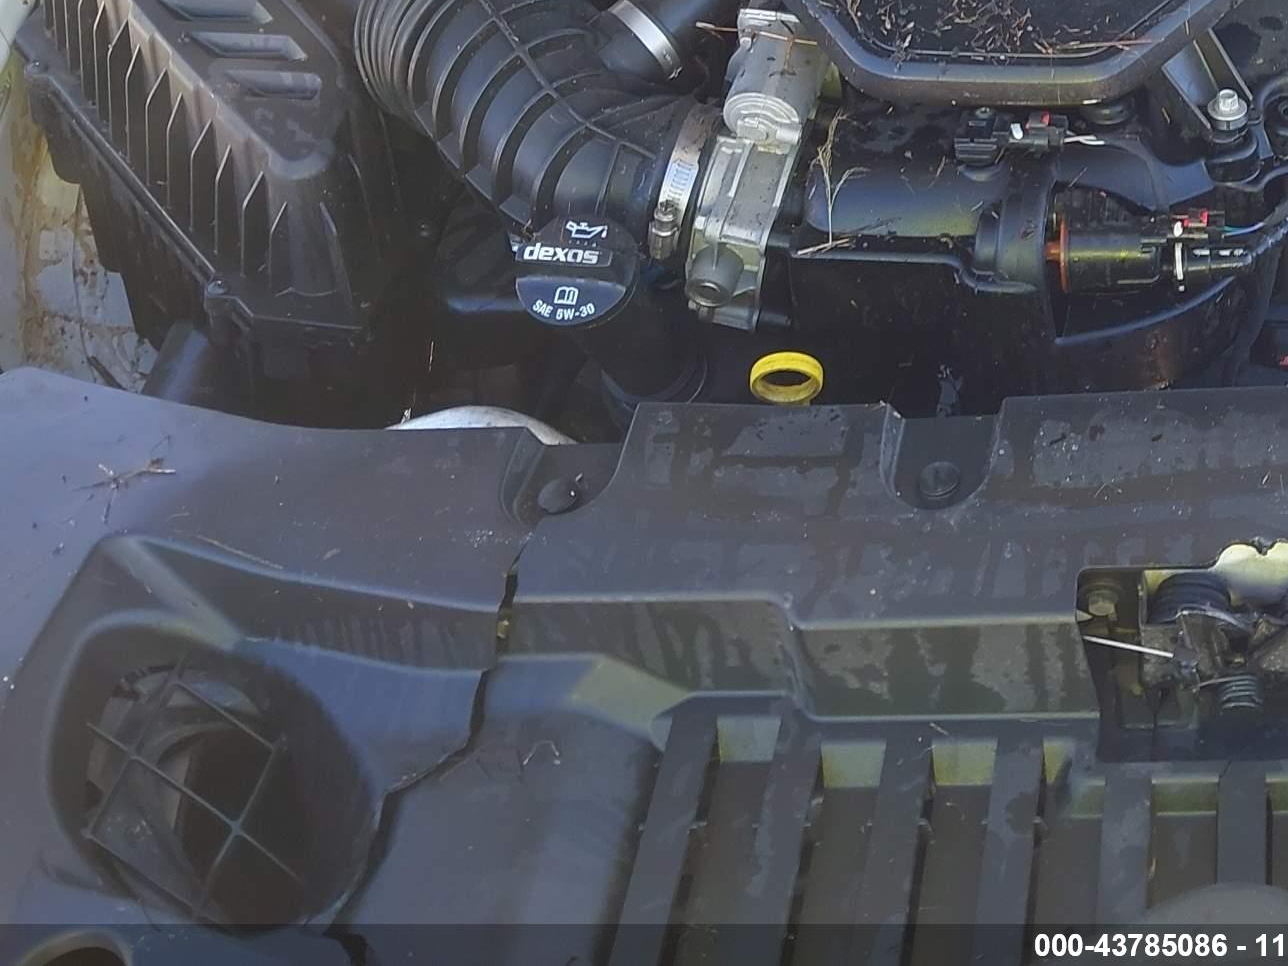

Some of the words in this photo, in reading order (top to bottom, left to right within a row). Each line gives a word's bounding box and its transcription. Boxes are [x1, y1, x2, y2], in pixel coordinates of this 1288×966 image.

[523, 243, 600, 264] dexos
[532, 300, 553, 318] SAE
[556, 303, 595, 320] 5W-30
